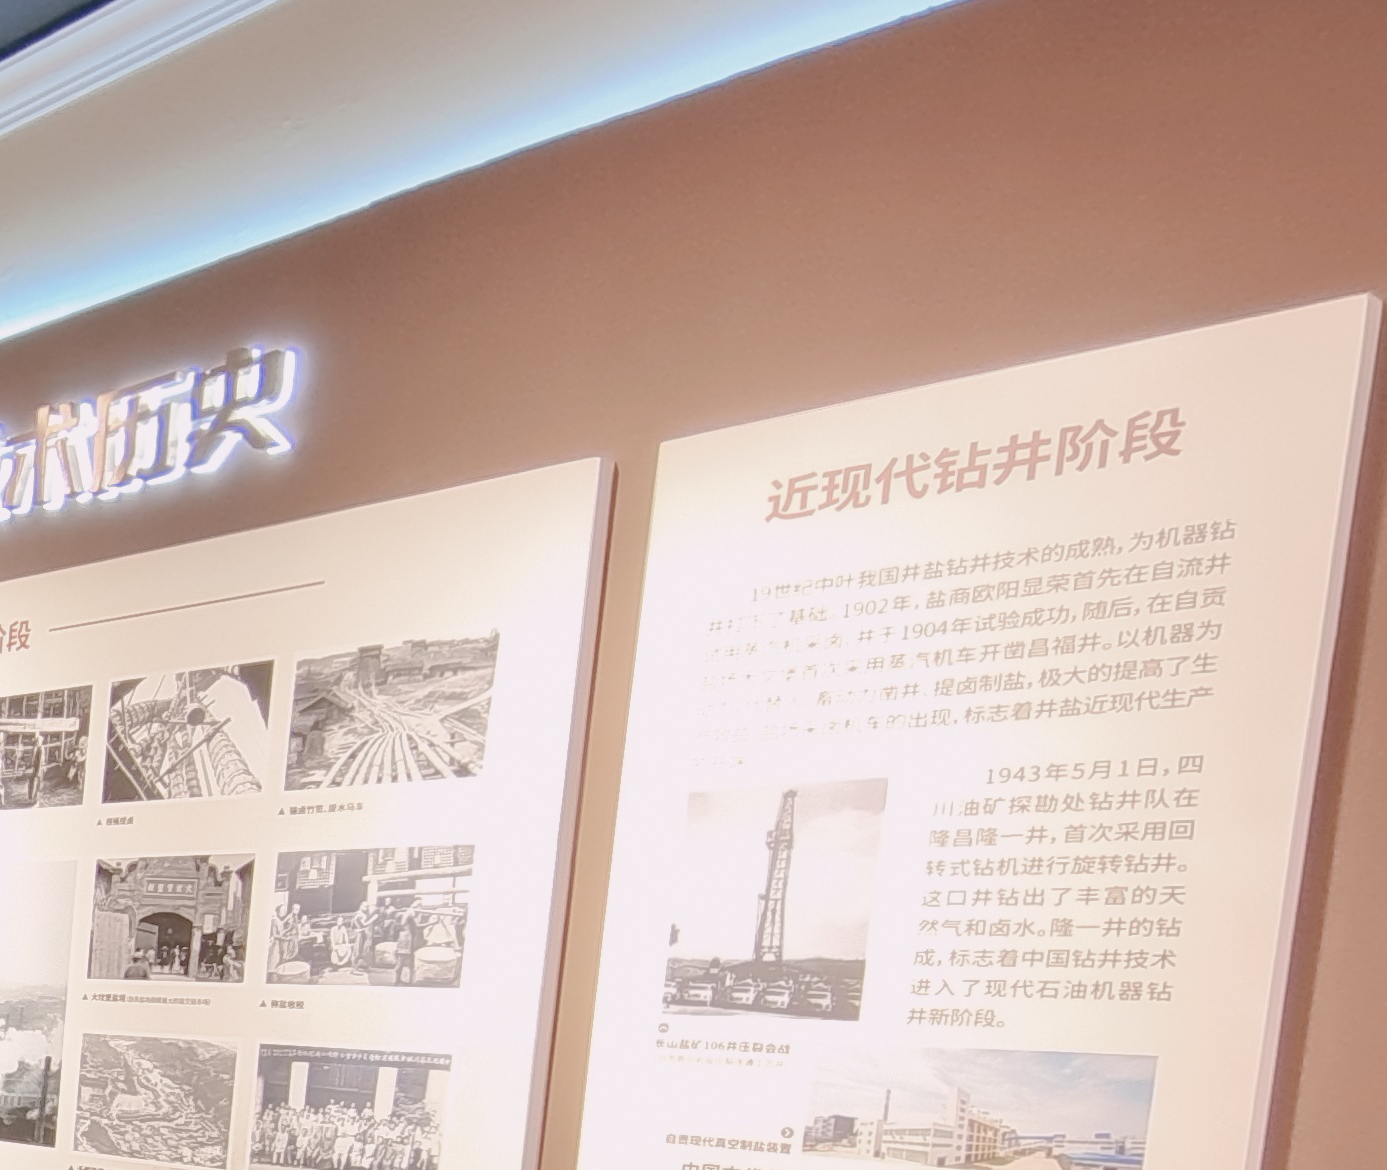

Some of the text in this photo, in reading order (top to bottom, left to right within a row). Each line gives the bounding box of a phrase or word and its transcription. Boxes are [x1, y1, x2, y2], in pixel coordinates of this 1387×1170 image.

[764, 406, 1187, 524] 近现代钻井阶段
[984, 754, 1205, 786] 1943年5月1日，四
[931, 786, 1201, 818] 川油矿探勘处钻井队在
[927, 818, 1196, 849] 隆昌隆一井，首次采用回
[924, 852, 1190, 879] 转式钻机进行旋转钻井。
[920, 883, 1188, 909] 这口井钻出了丰富的天
[916, 915, 1183, 940] 然气和卤水。隆一井的钻
[911, 946, 1178, 971] 成，标志着中国钻井技术
[908, 977, 1174, 1003] 进入了现代石油机器钻
[905, 1007, 1008, 1029] 井新阶段。
[665, 1133, 793, 1155] 自贡现代真空制盐装置
